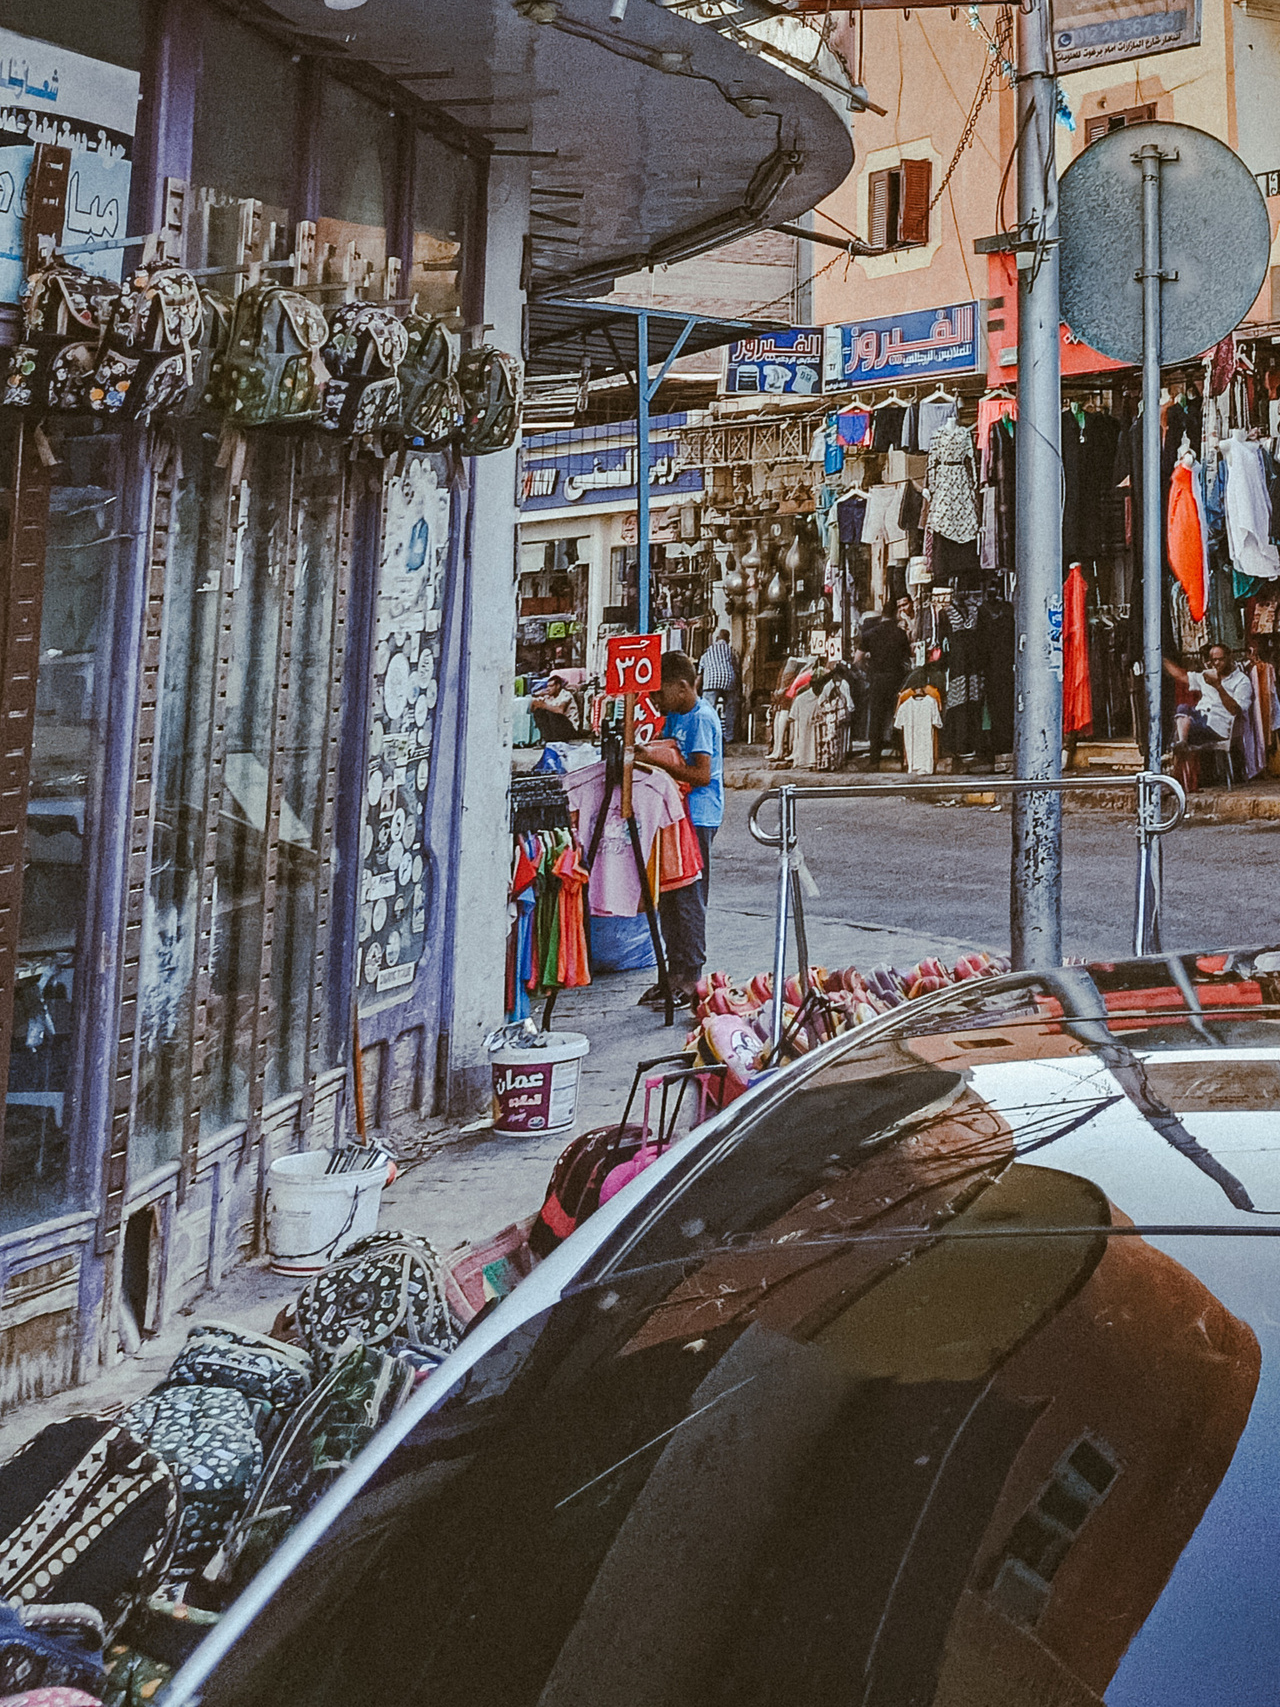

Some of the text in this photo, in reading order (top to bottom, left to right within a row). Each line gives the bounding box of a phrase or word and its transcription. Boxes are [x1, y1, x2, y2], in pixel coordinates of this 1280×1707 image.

[845, 305, 973, 374] الفيروز
[615, 656, 653, 688] ٣٥
[496, 1068, 544, 1095] عمان
